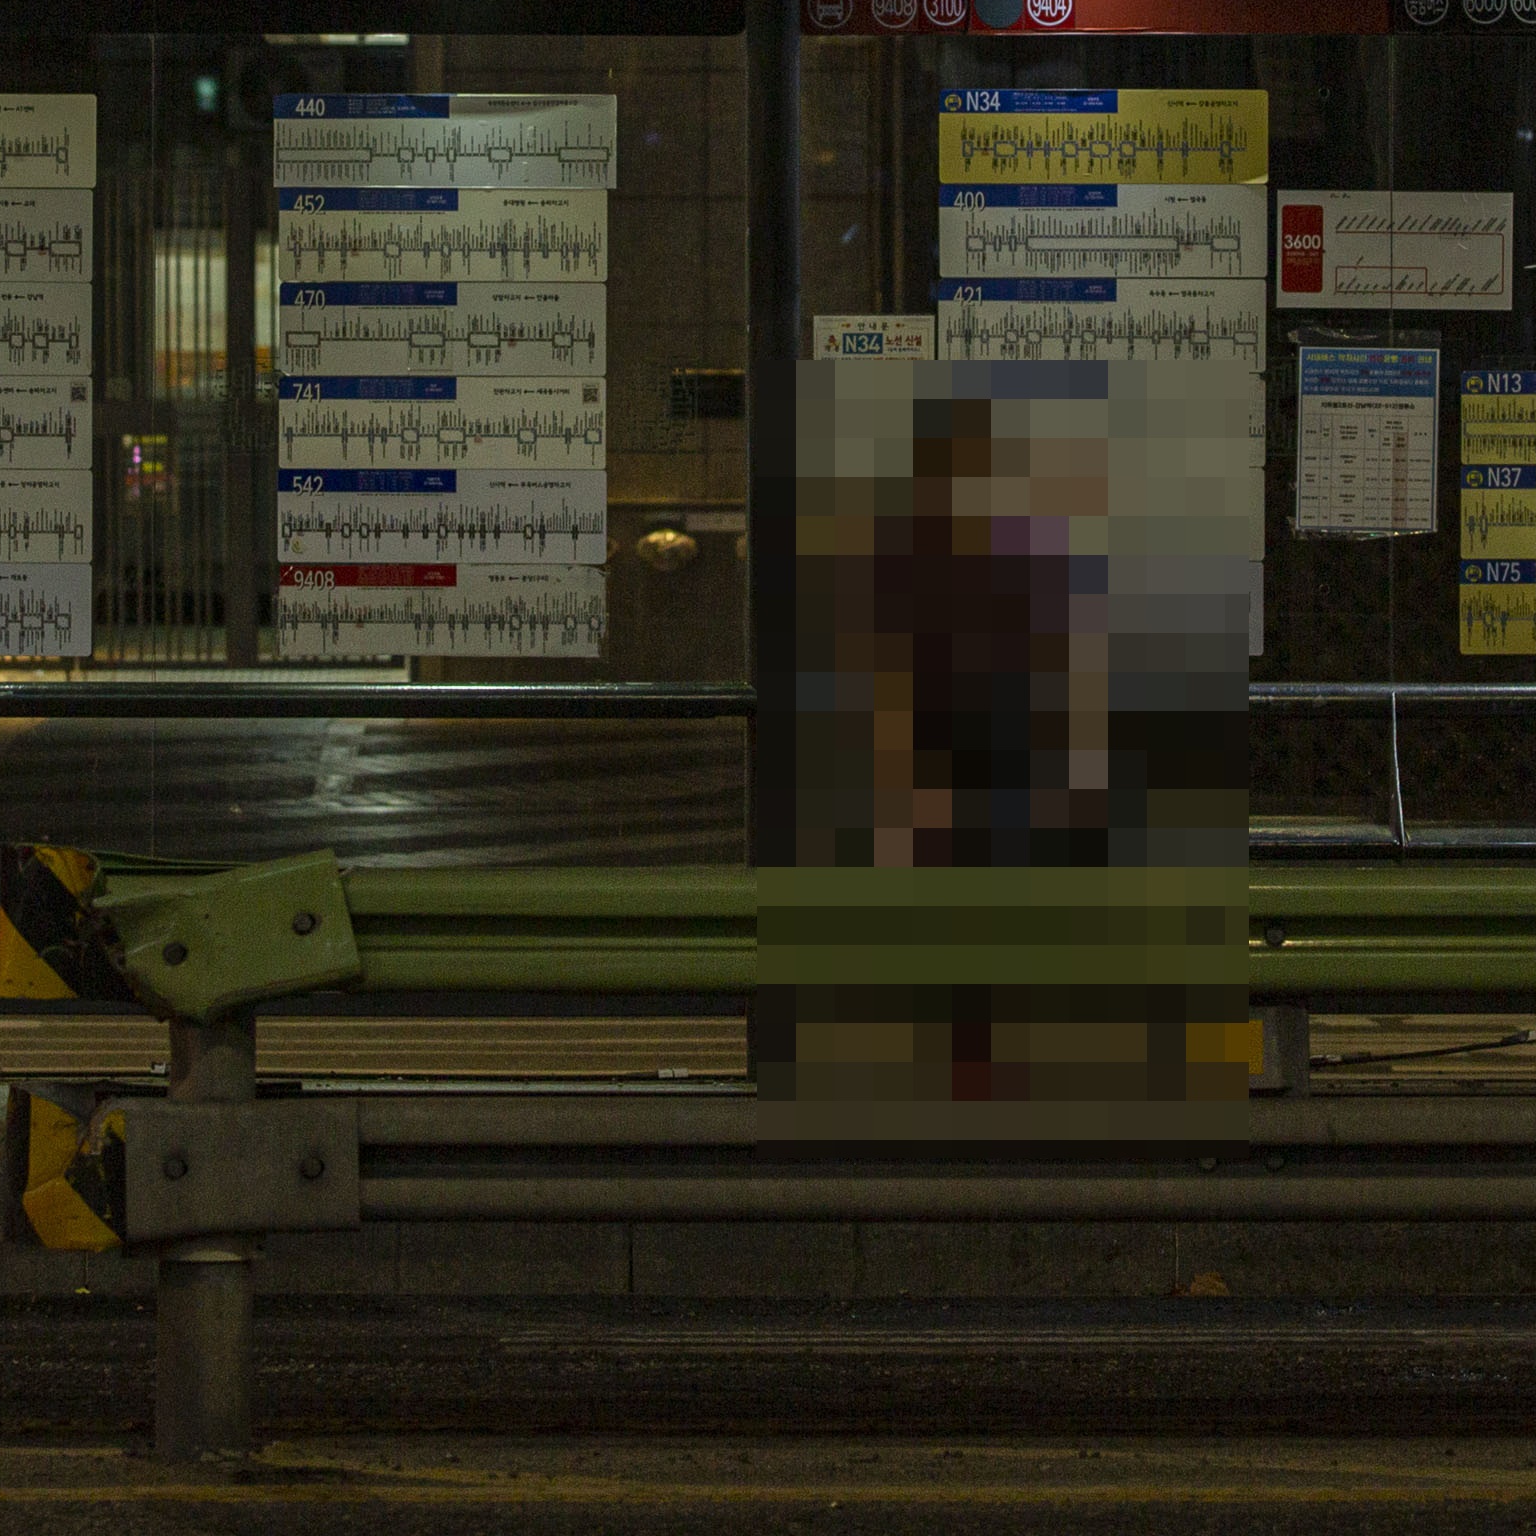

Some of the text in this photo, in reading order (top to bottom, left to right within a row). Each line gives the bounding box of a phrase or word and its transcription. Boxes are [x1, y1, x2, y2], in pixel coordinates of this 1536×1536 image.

[295, 98, 325, 116] 440
[967, 91, 1000, 111] N34
[293, 195, 325, 214] 452
[953, 191, 986, 212] 400
[1284, 234, 1321, 250] 3600
[294, 289, 325, 309] 470
[953, 286, 983, 307] 421
[845, 335, 880, 353] N34
[293, 383, 321, 402] 741
[1487, 373, 1522, 393] N13
[292, 475, 324, 494] 542
[1488, 468, 1522, 487] N37
[294, 570, 335, 590] 9408
[1486, 563, 1521, 582] N75
